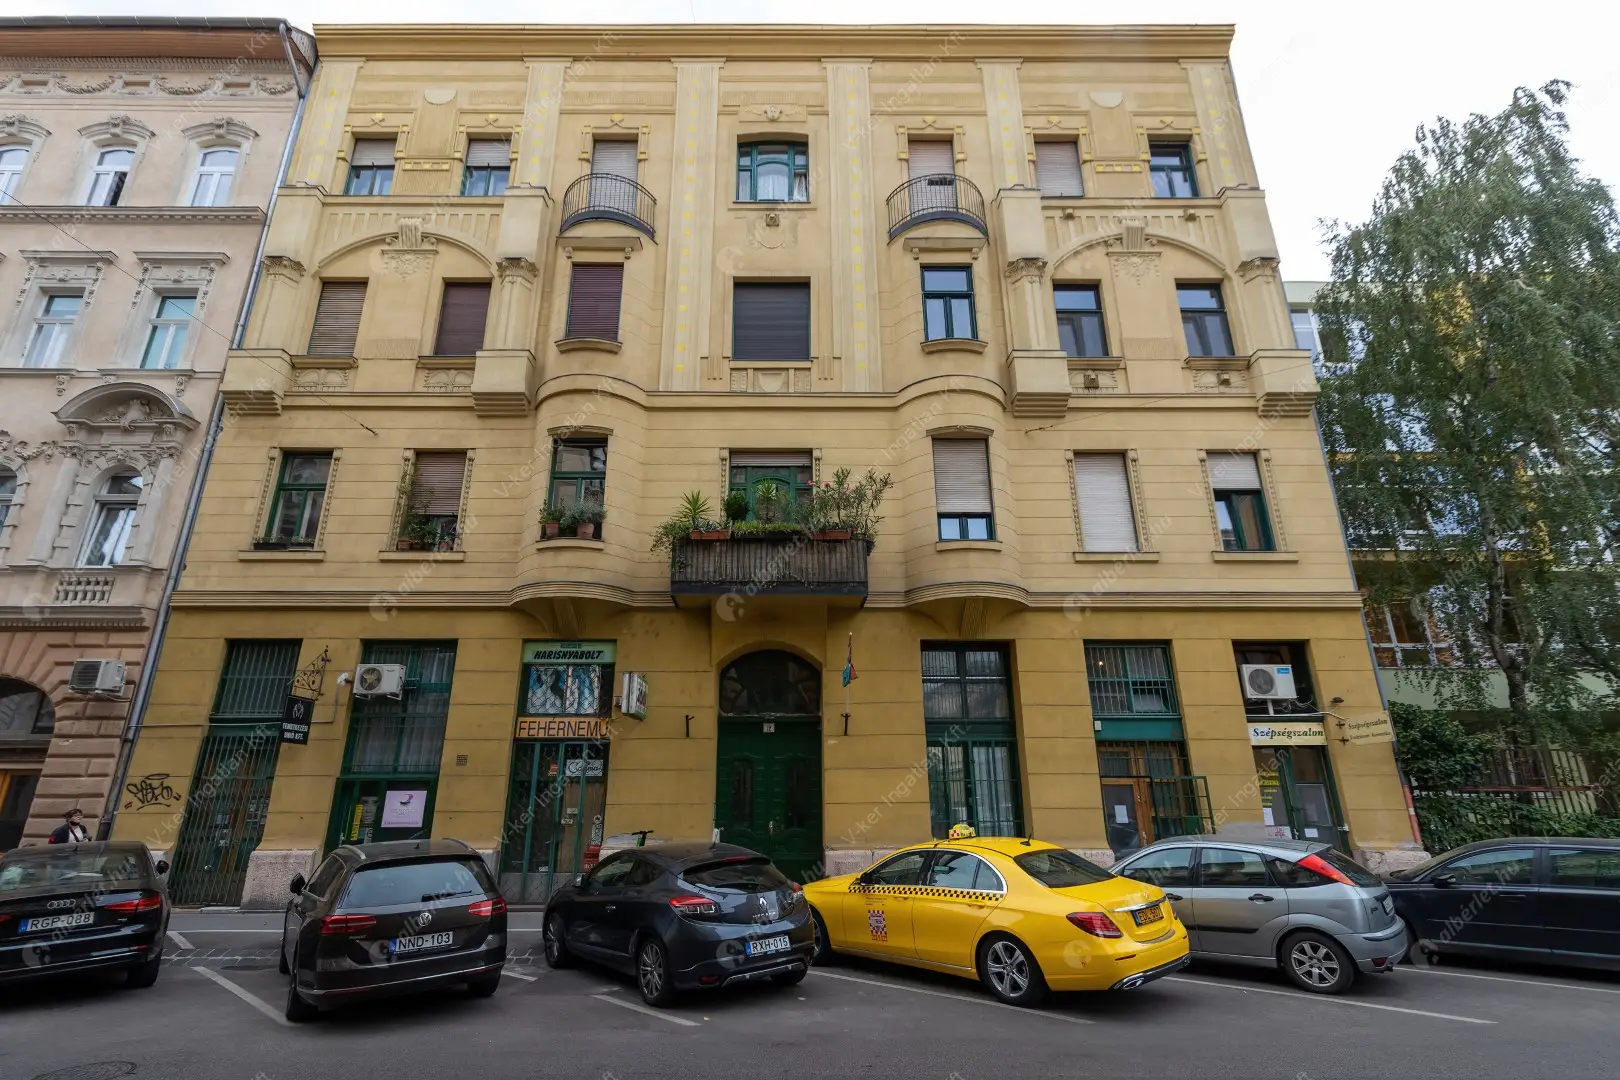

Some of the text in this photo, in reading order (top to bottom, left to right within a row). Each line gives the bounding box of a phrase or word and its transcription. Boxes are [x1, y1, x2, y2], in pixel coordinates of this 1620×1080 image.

[533, 649, 604, 660] HARISNYABOLT
[1252, 727, 1324, 741] Szépségszalon
[30, 913, 91, 930] RGP-088
[398, 933, 451, 951] NND-103
[752, 937, 789, 954] RXH-015
